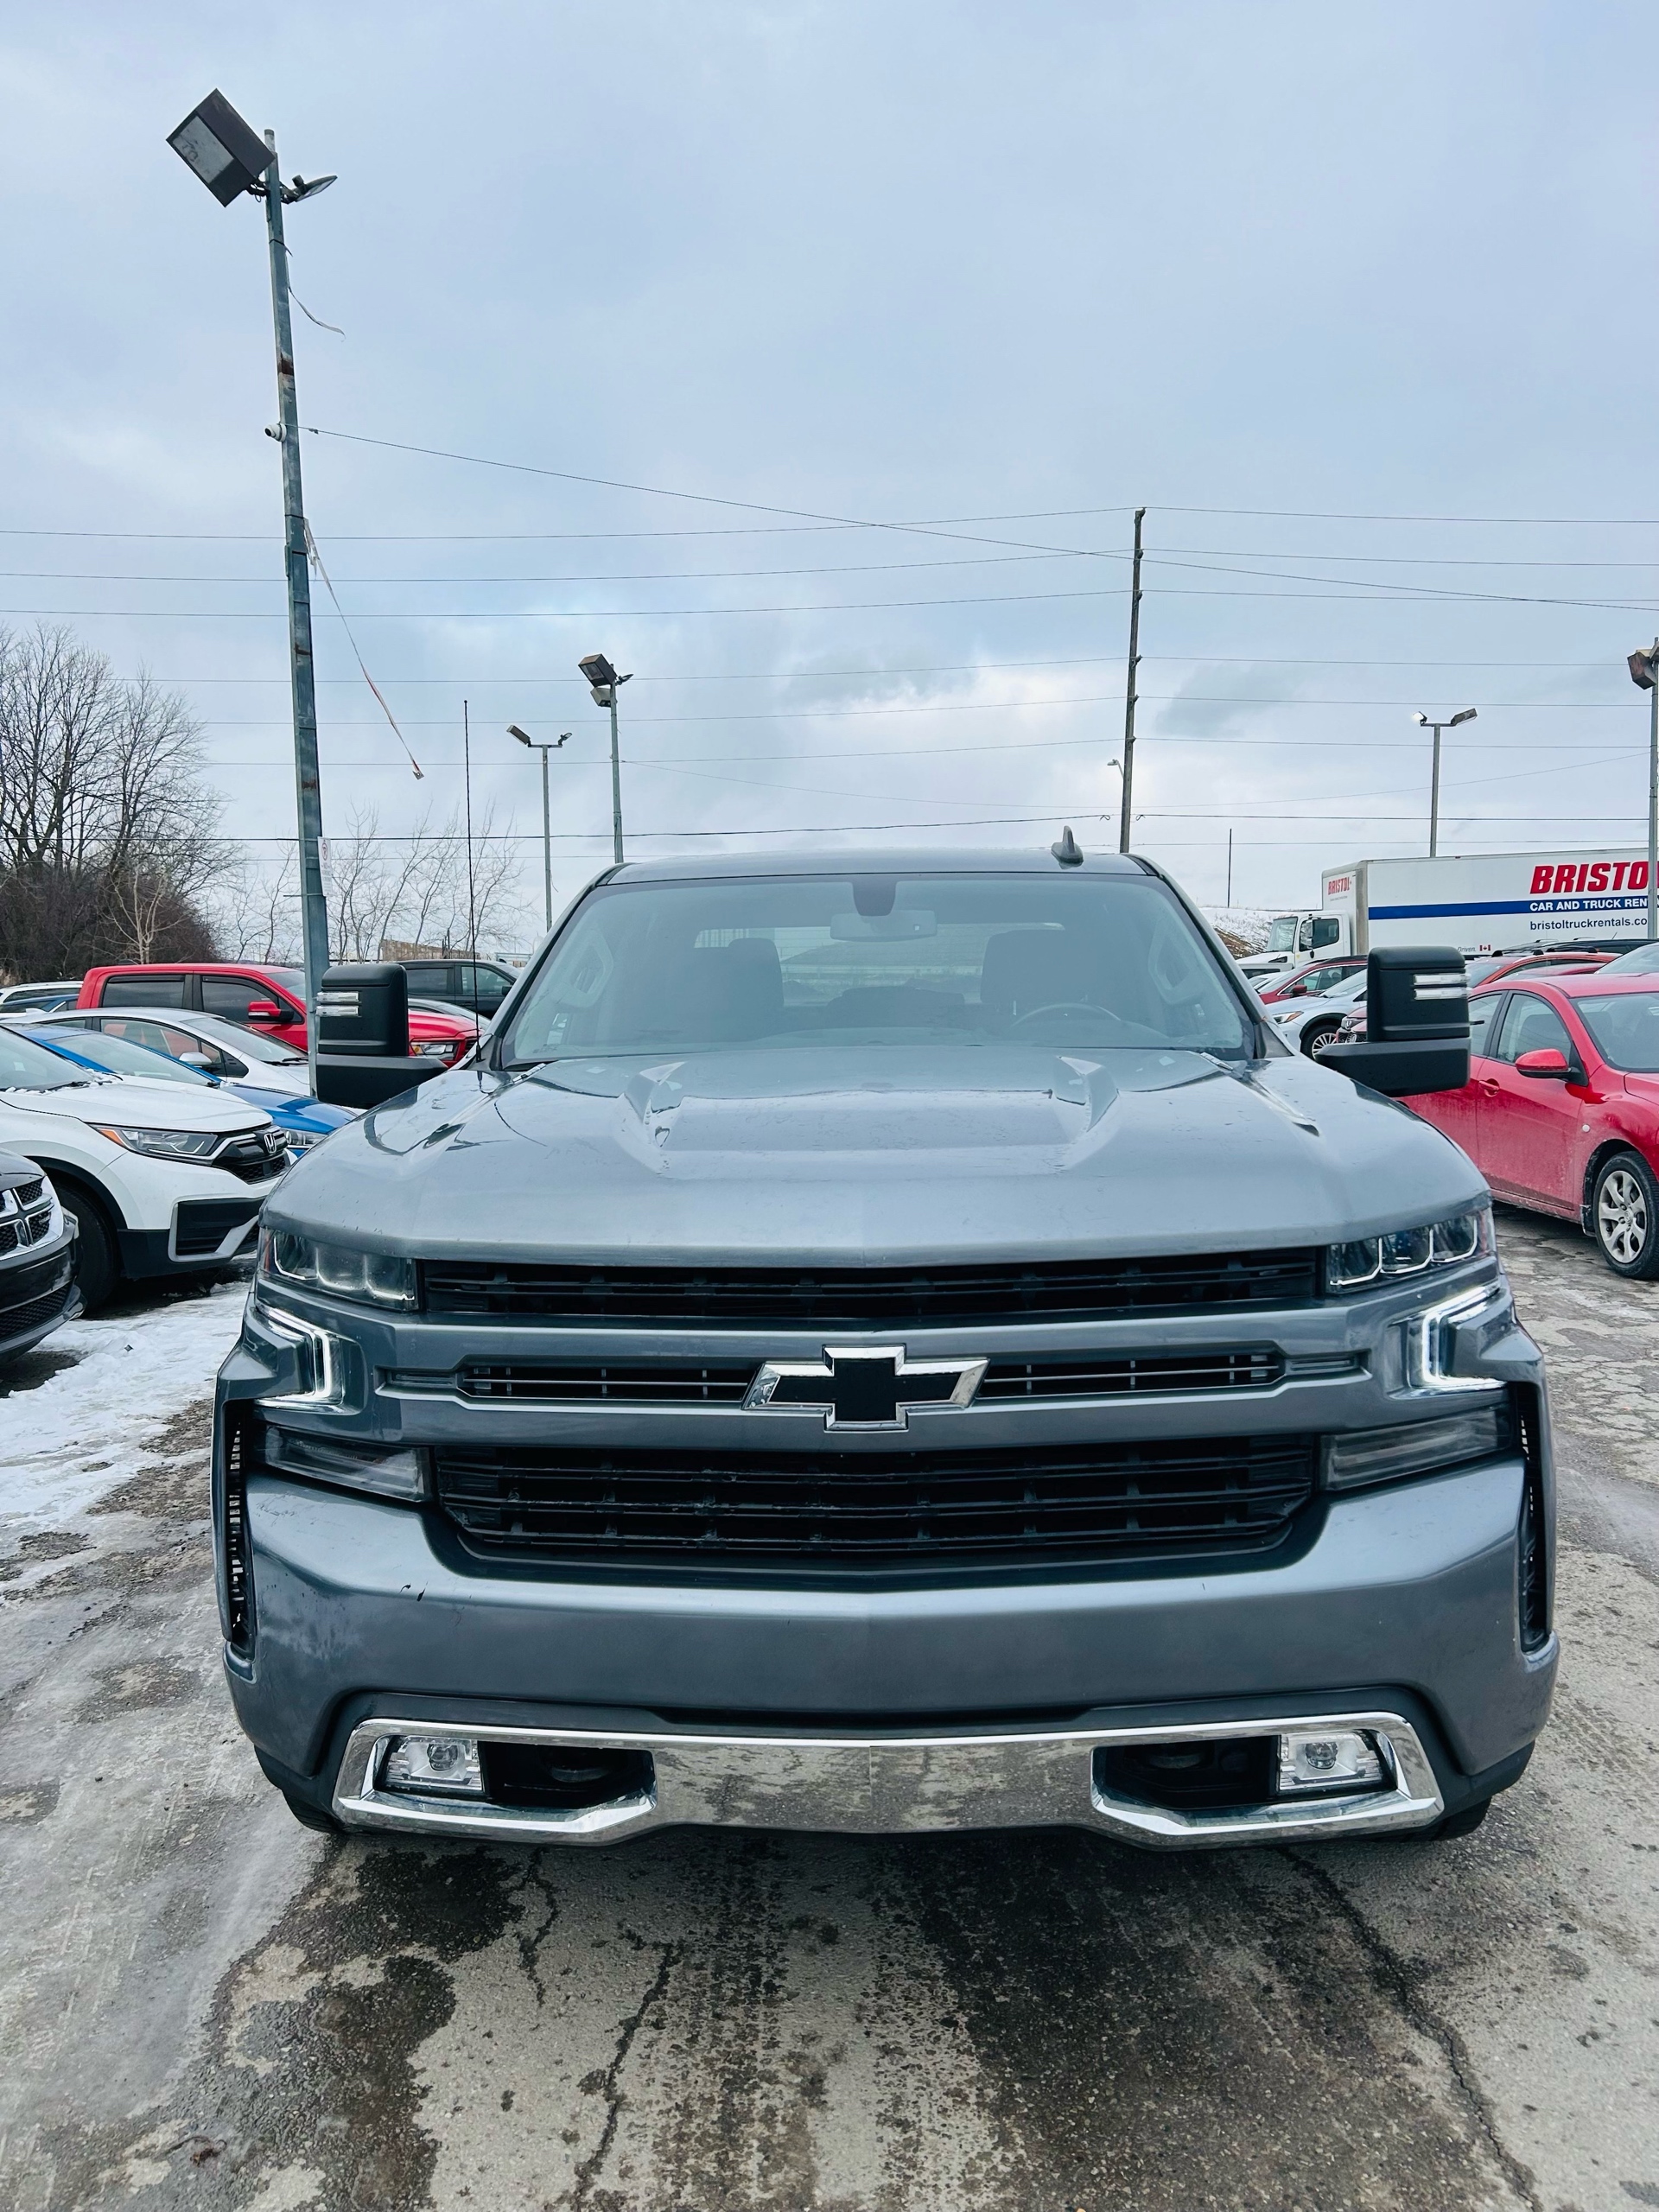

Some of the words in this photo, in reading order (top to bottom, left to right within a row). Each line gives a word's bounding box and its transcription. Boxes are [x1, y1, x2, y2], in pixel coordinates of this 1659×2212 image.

[1529, 861, 1659, 894] BRISTO
[1328, 877, 1350, 895] BRISTOL
[1529, 901, 1554, 912] CAR
[1556, 900, 1580, 911] AND
[1583, 899, 1622, 909] TRUCK
[1624, 898, 1659, 908] REN
[1529, 917, 1648, 931] bristoltruckrentals.co
